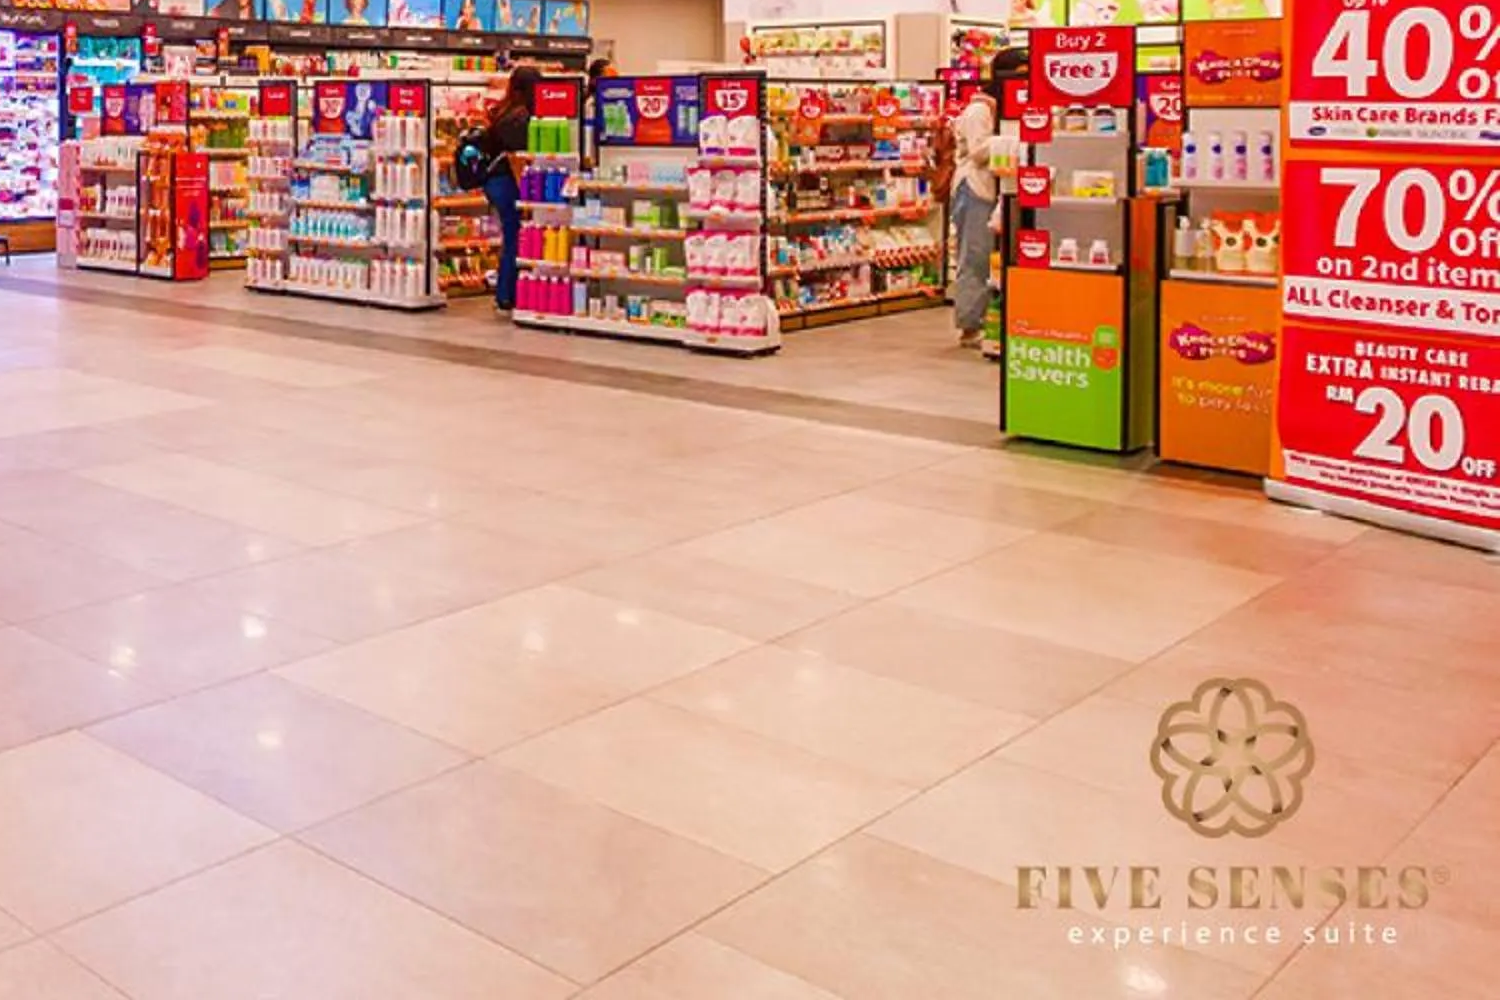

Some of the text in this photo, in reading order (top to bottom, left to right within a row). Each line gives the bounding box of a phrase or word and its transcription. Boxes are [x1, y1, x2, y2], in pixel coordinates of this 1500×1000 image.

[1056, 32, 1106, 51] Buy 2
[1049, 60, 1111, 79] Free 1
[1312, 106, 1500, 126] Skin Care Brands F
[1449, 227, 1500, 258] Of
[1316, 255, 1500, 288] on 2nd item
[1287, 285, 1323, 307] ALL
[1328, 289, 1431, 318] Cleanser
[1435, 299, 1454, 319] &
[1009, 339, 1091, 369] Health
[1355, 341, 1469, 367] BEAUTY CARE
[1008, 359, 1089, 389] Savers
[1306, 353, 1374, 380] EXTRA
[1380, 366, 1452, 388] INSTANT
[1326, 384, 1465, 471] RM 20
[1461, 456, 1497, 479] OFF
